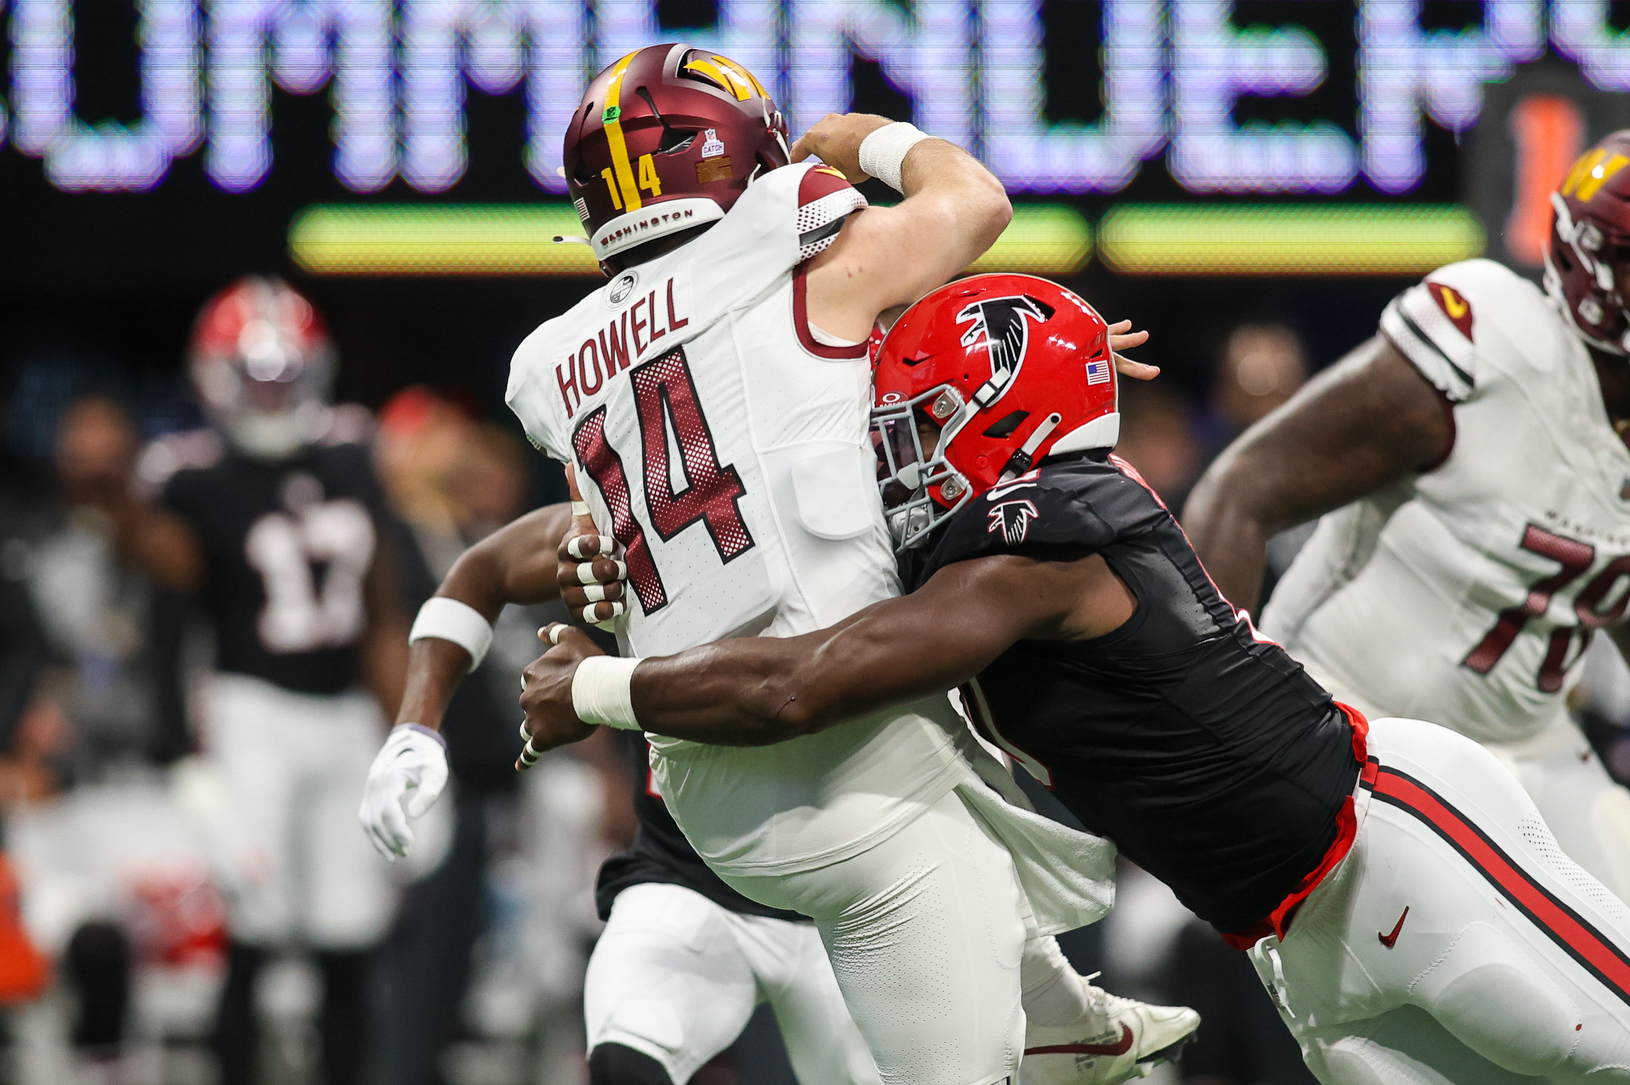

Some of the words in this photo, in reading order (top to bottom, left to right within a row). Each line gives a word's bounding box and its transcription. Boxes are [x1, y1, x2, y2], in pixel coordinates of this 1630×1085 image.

[600, 153, 662, 211] 14
[600, 209, 694, 247] WASHINGTON
[556, 277, 689, 419] HOWELL
[571, 344, 756, 617] 14
[246, 498, 376, 655] 17
